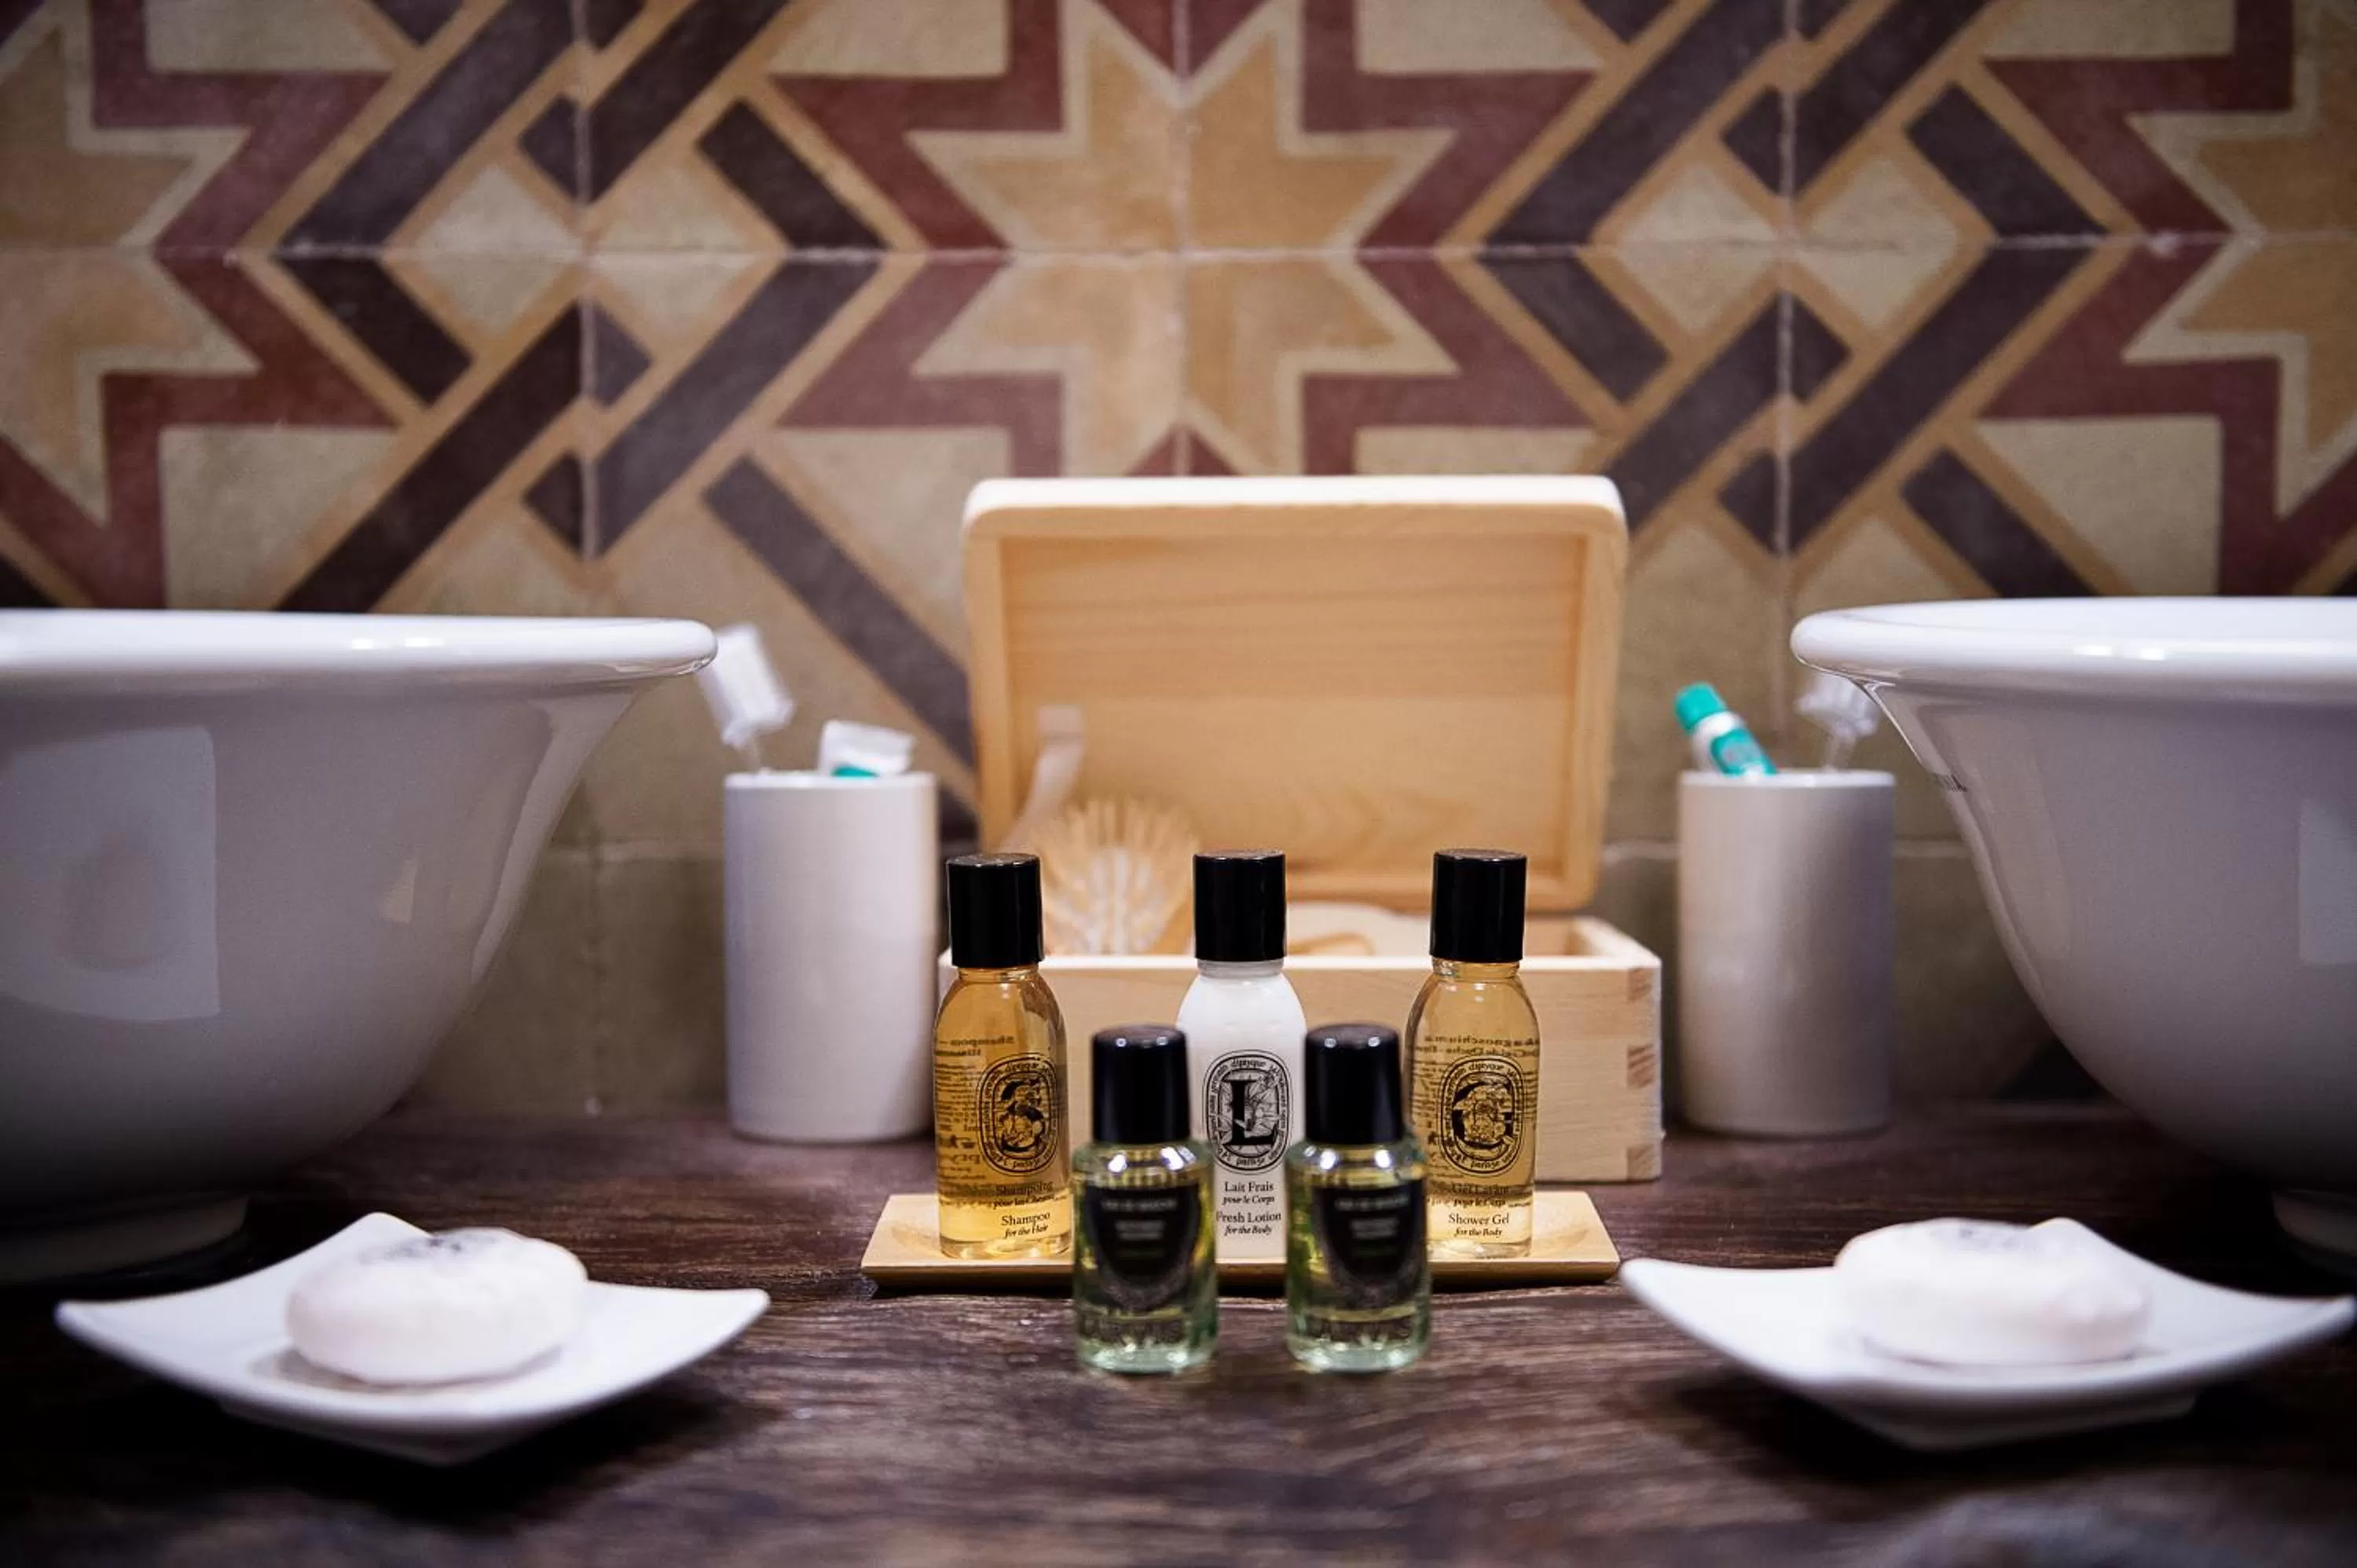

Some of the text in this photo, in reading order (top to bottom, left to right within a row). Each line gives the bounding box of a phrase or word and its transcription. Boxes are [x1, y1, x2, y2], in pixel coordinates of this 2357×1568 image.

[1225, 1181, 1274, 1192] Lait Frais
[1001, 1212, 1050, 1226] Shampoo
[1215, 1211, 1281, 1223] Fresh Lotion
[1448, 1212, 1509, 1225] Shower Gel
